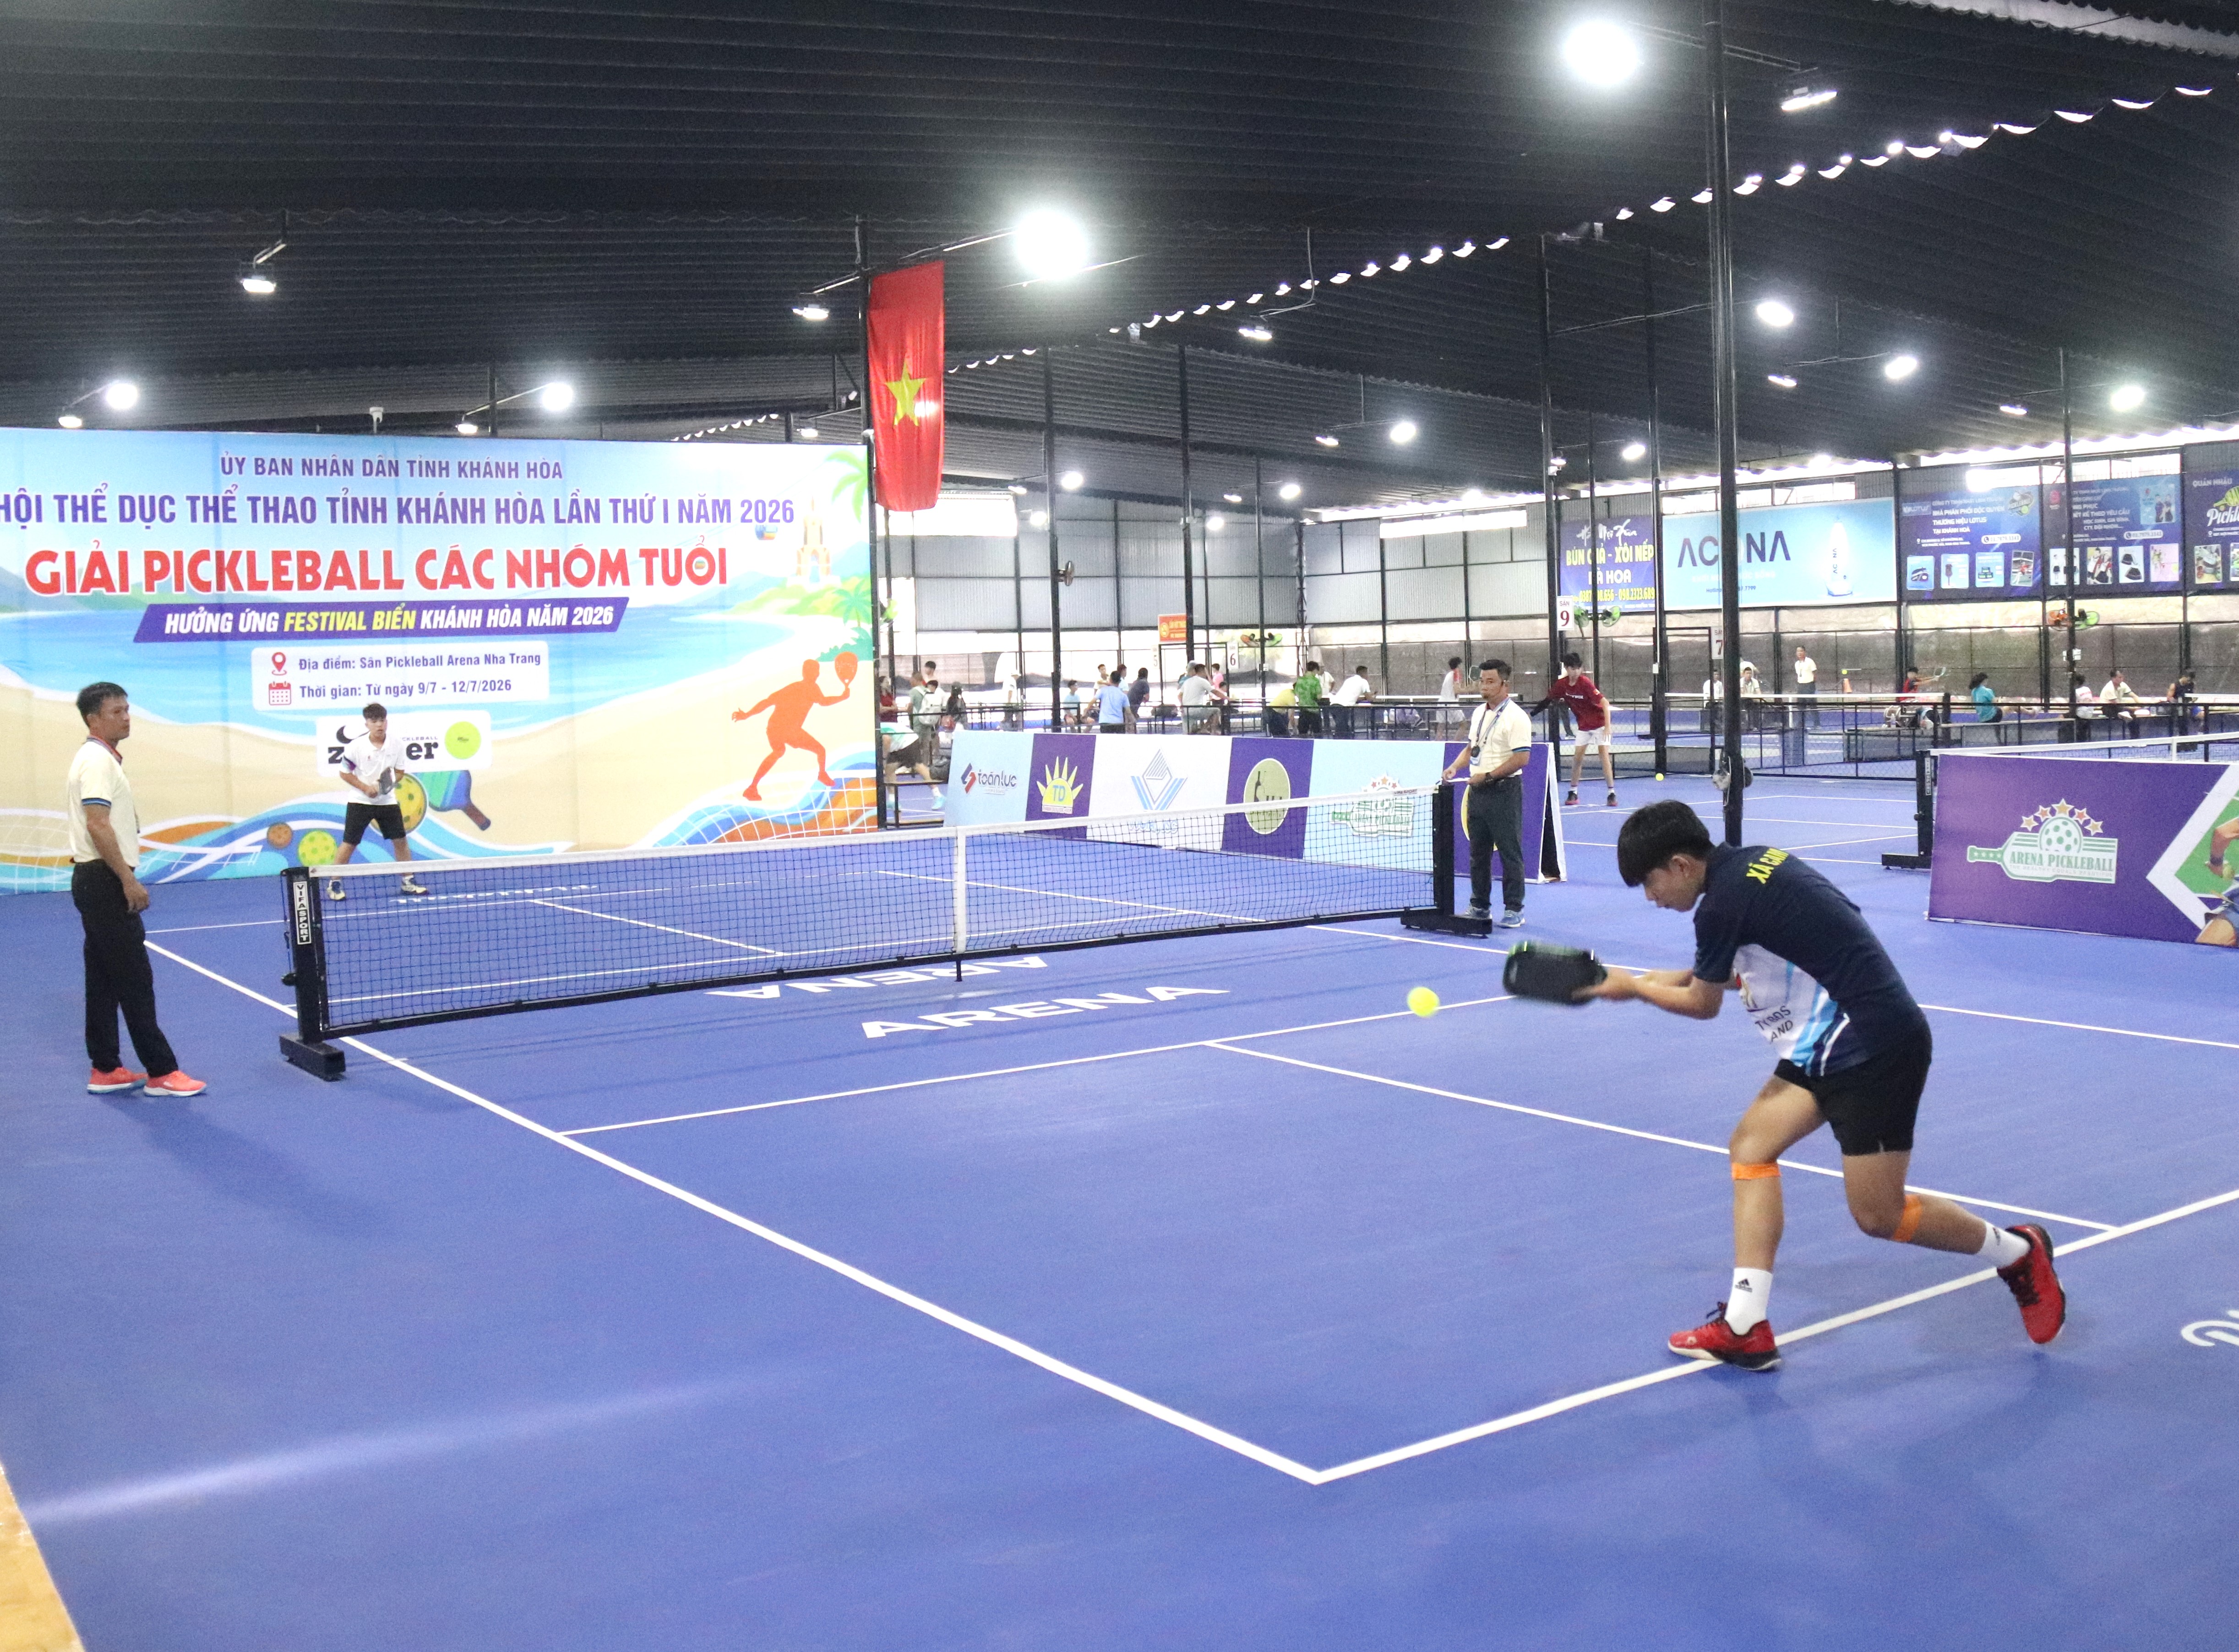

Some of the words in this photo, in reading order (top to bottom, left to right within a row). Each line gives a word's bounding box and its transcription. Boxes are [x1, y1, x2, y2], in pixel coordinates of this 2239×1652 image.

[220, 451, 245, 475] ỦY
[255, 458, 293, 476] BAN
[302, 454, 354, 477] NHÂN
[362, 454, 399, 477] DÂN
[407, 454, 450, 478] TỈNH
[458, 457, 518, 478] KHÁNH
[527, 457, 562, 478] HÒA
[53, 483, 108, 523] THỂ
[118, 495, 176, 529] DỤC
[186, 484, 238, 523] THỂ
[246, 496, 316, 523] THAO
[326, 487, 387, 523] TỈNH
[397, 491, 485, 524] KHÁNH
[495, 491, 545, 524] HÒA
[554, 489, 600, 523] LẦN
[609, 493, 656, 524] THỨ
[663, 499, 669, 523] I
[678, 493, 731, 523] NĂM
[740, 499, 794, 523] 2026
[1566, 546, 1585, 565] BÚN
[1614, 542, 1633, 563] XÔI
[1635, 538, 1654, 562] NẾP
[25, 540, 129, 594] GIẢI
[144, 549, 404, 593] PICKLEBALL
[415, 544, 494, 590] CÁC
[506, 543, 630, 588] NHÓM
[639, 535, 727, 587] TUỔI
[1606, 569, 1631, 584] HOA
[165, 607, 234, 634] HƯỞNG
[239, 608, 279, 632] ỨNG
[284, 611, 366, 632] FESTIVAL
[372, 603, 416, 630] BIỂN
[420, 605, 482, 629] KHÁNH
[486, 604, 521, 628] HÒA
[527, 603, 568, 627] NĂM
[572, 606, 614, 626] 2026
[1560, 610, 1570, 626] 9
[1716, 640, 1722, 655] 7
[299, 659, 318, 673] Địa
[323, 656, 355, 670] điểm:
[360, 657, 381, 669] Sân
[386, 655, 443, 668] Pickleball
[447, 654, 480, 666] Arena
[484, 654, 505, 665] Nha
[509, 653, 541, 666] Trang
[1154, 655, 1158, 666] 5
[1230, 653, 1236, 666] 6
[300, 685, 326, 698] Thời
[331, 686, 361, 699] gian:
[365, 683, 381, 696] Từ
[386, 683, 413, 697] ngày
[419, 682, 436, 695] 9/7
[451, 679, 512, 693] 12/7/2026
[1052, 785, 1066, 802] TD
[2010, 851, 2043, 866] ARENA
[2048, 854, 2113, 871] PICKLEBALL
[703, 956, 1048, 1000] ARENA
[861, 986, 1231, 1038] ARENA
